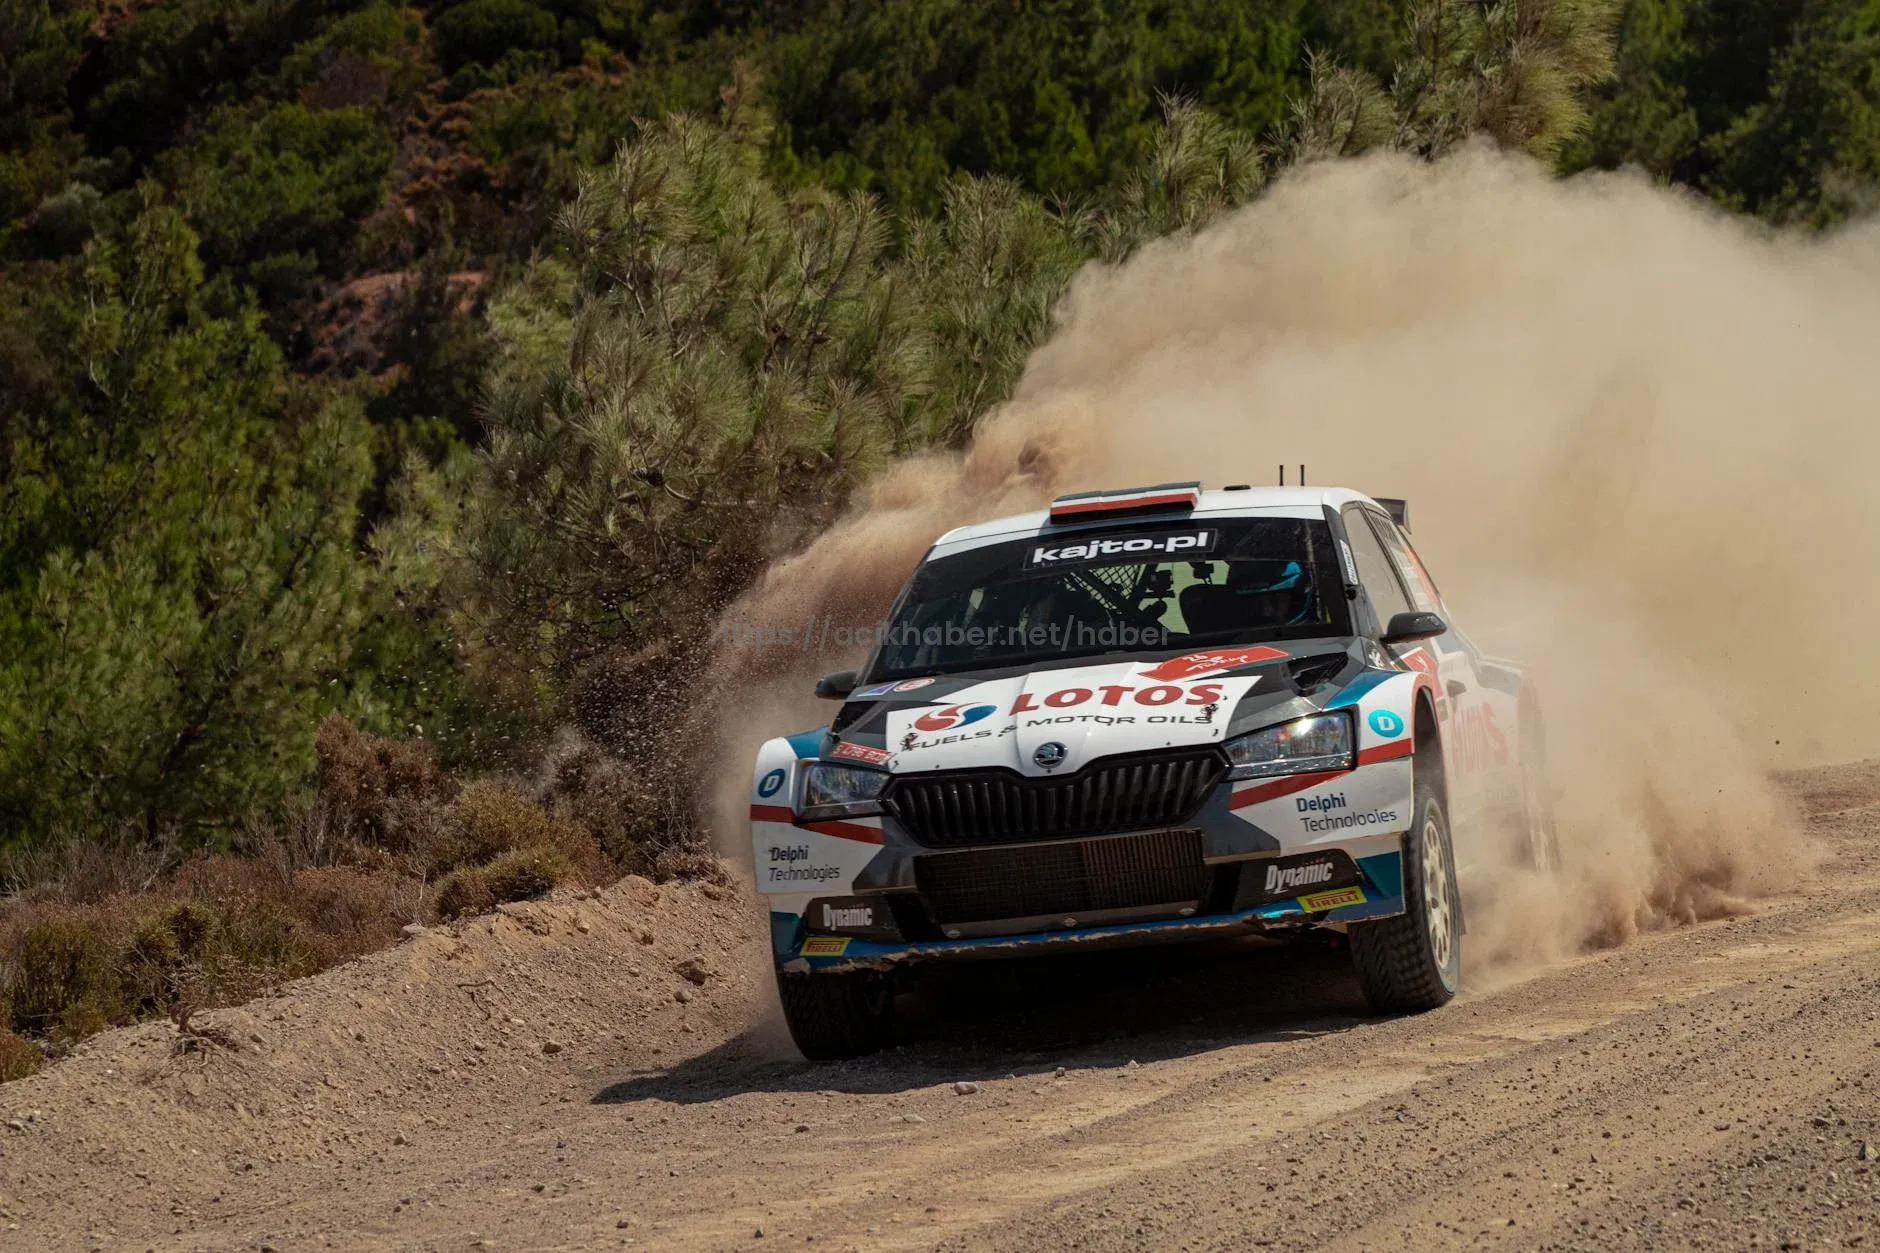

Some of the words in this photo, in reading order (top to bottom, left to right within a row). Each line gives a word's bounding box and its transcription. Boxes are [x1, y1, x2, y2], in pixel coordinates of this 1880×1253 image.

[1032, 532, 1209, 564] kajto.pl
[1009, 684, 1224, 716] LOTOS
[1027, 715, 1135, 727] MOTOR
[1147, 715, 1213, 725] OILS
[1296, 792, 1347, 813] Delphi
[770, 844, 809, 863] Delphi
[768, 864, 840, 882] Technologies
[1264, 861, 1334, 894] Dynamic
[1307, 889, 1361, 909] PIRELLI
[822, 903, 873, 931] Dynamic
